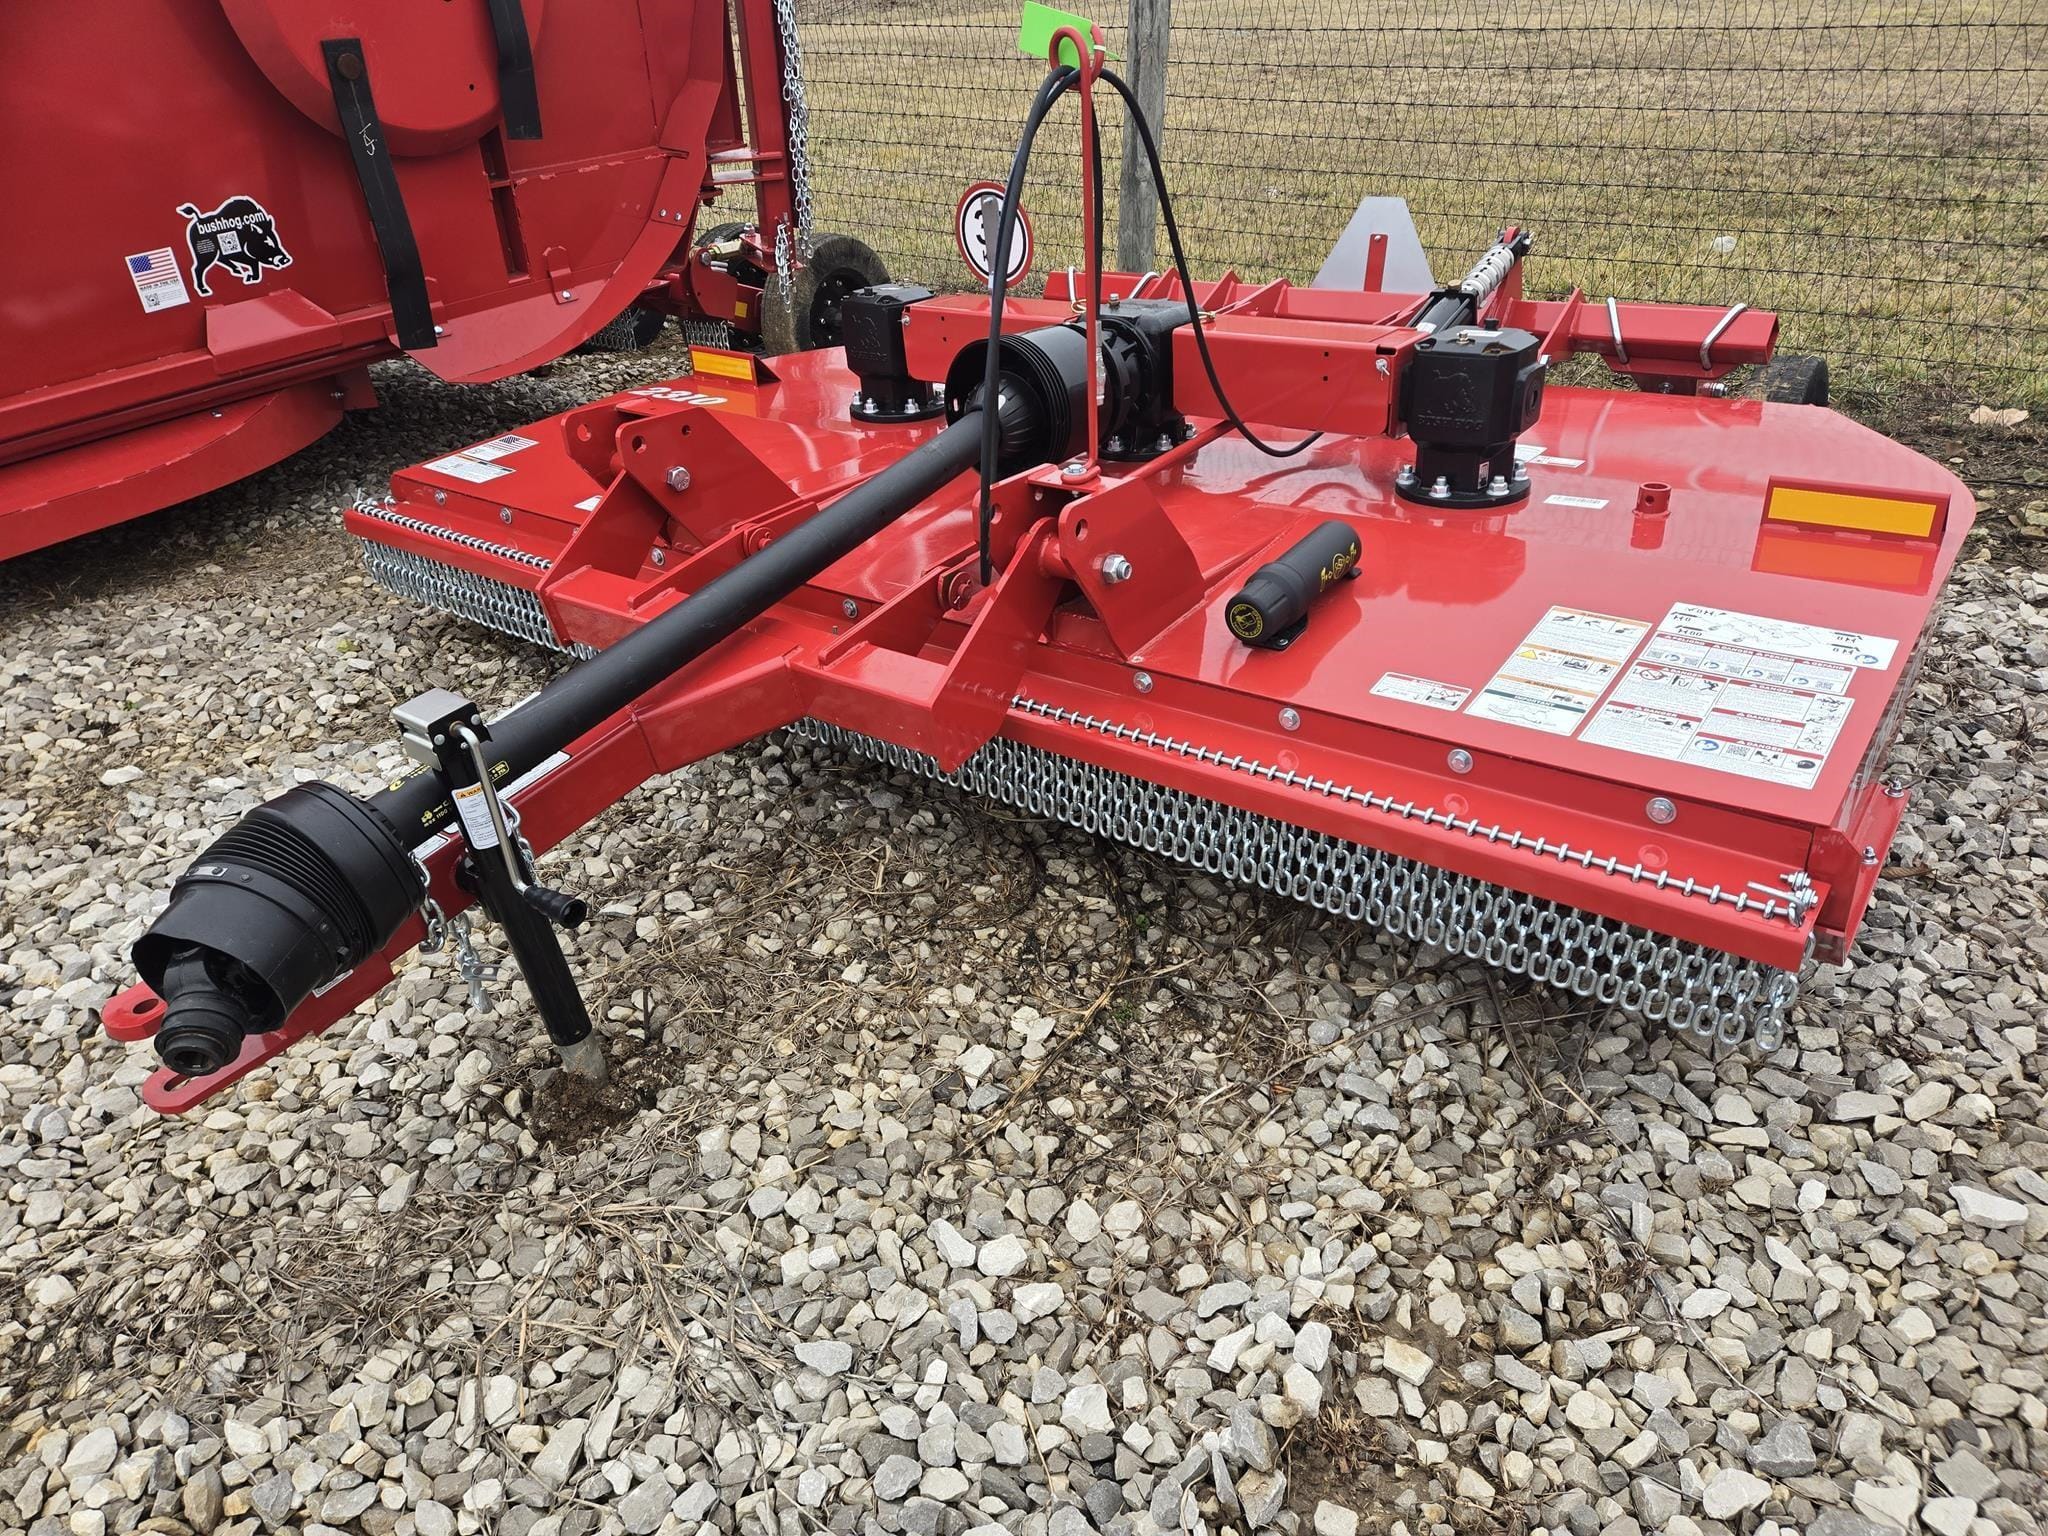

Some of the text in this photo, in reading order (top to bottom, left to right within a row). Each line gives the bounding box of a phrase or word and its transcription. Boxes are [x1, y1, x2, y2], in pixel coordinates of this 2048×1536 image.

[196, 212, 266, 235] bushhog.com
[628, 387, 728, 405] 2310
[1720, 645, 1754, 656] DANGER
[1671, 668, 1703, 679] DANGER
[1533, 680, 1569, 692] WARNING
[1758, 684, 1794, 695] DANGER
[1643, 707, 1678, 718] DANGER
[1747, 713, 1783, 724] DANGER
[1747, 741, 1784, 753] DANGER
